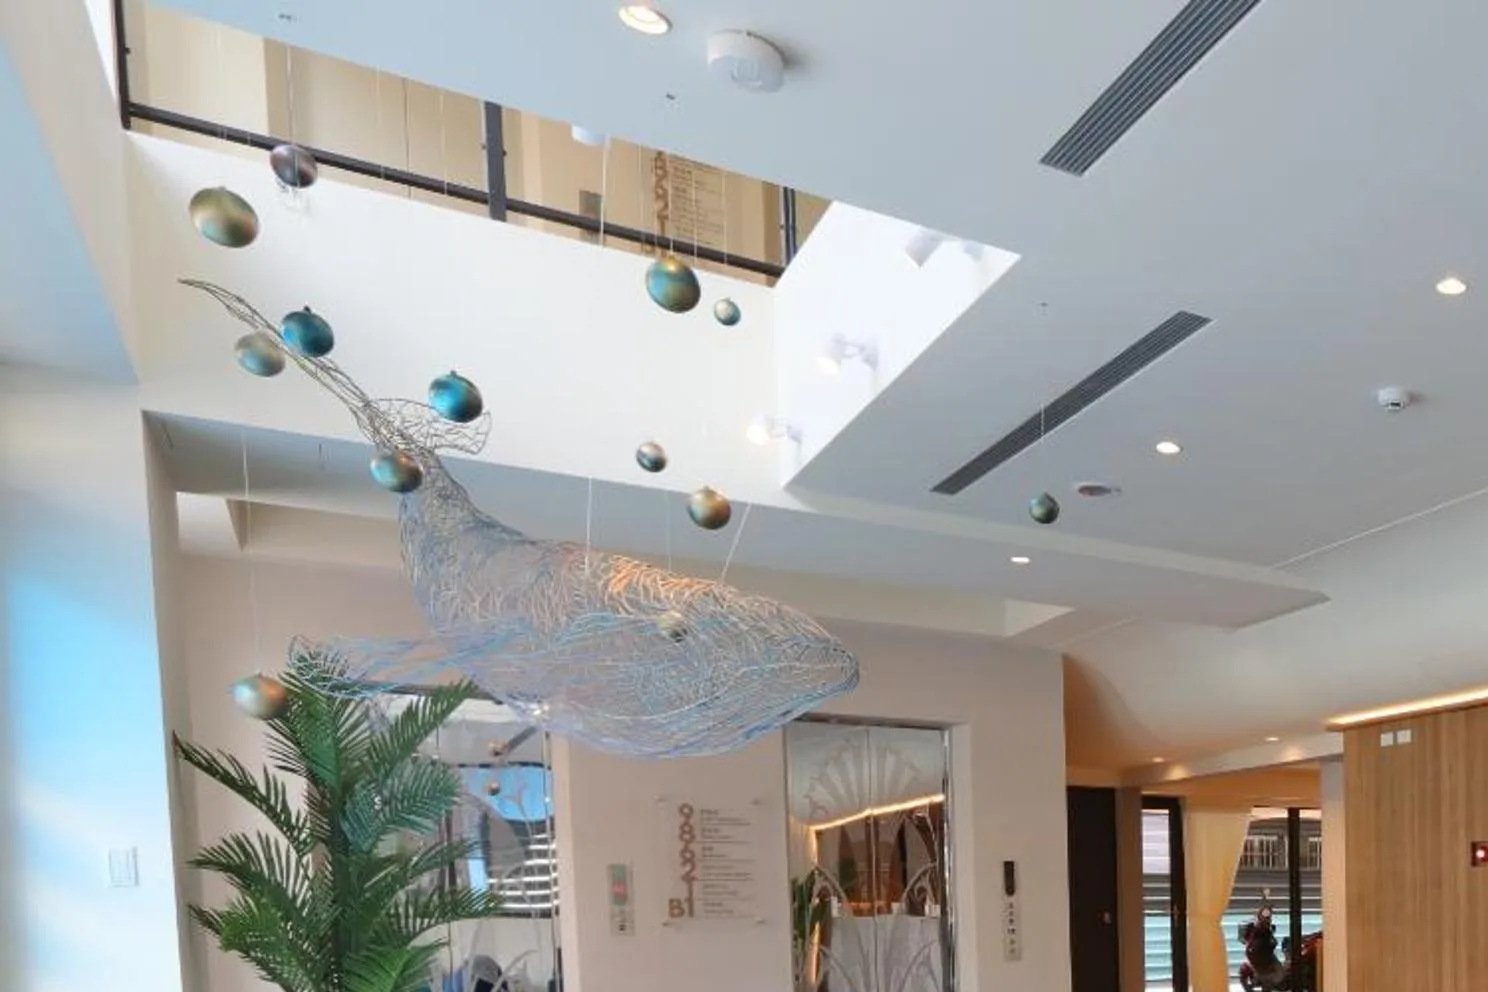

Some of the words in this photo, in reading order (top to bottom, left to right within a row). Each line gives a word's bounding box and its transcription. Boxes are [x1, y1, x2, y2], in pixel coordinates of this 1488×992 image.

[678, 803, 694, 822] 9
[678, 822, 696, 842] 8
[680, 860, 697, 881] 2
[668, 897, 695, 918] B1
